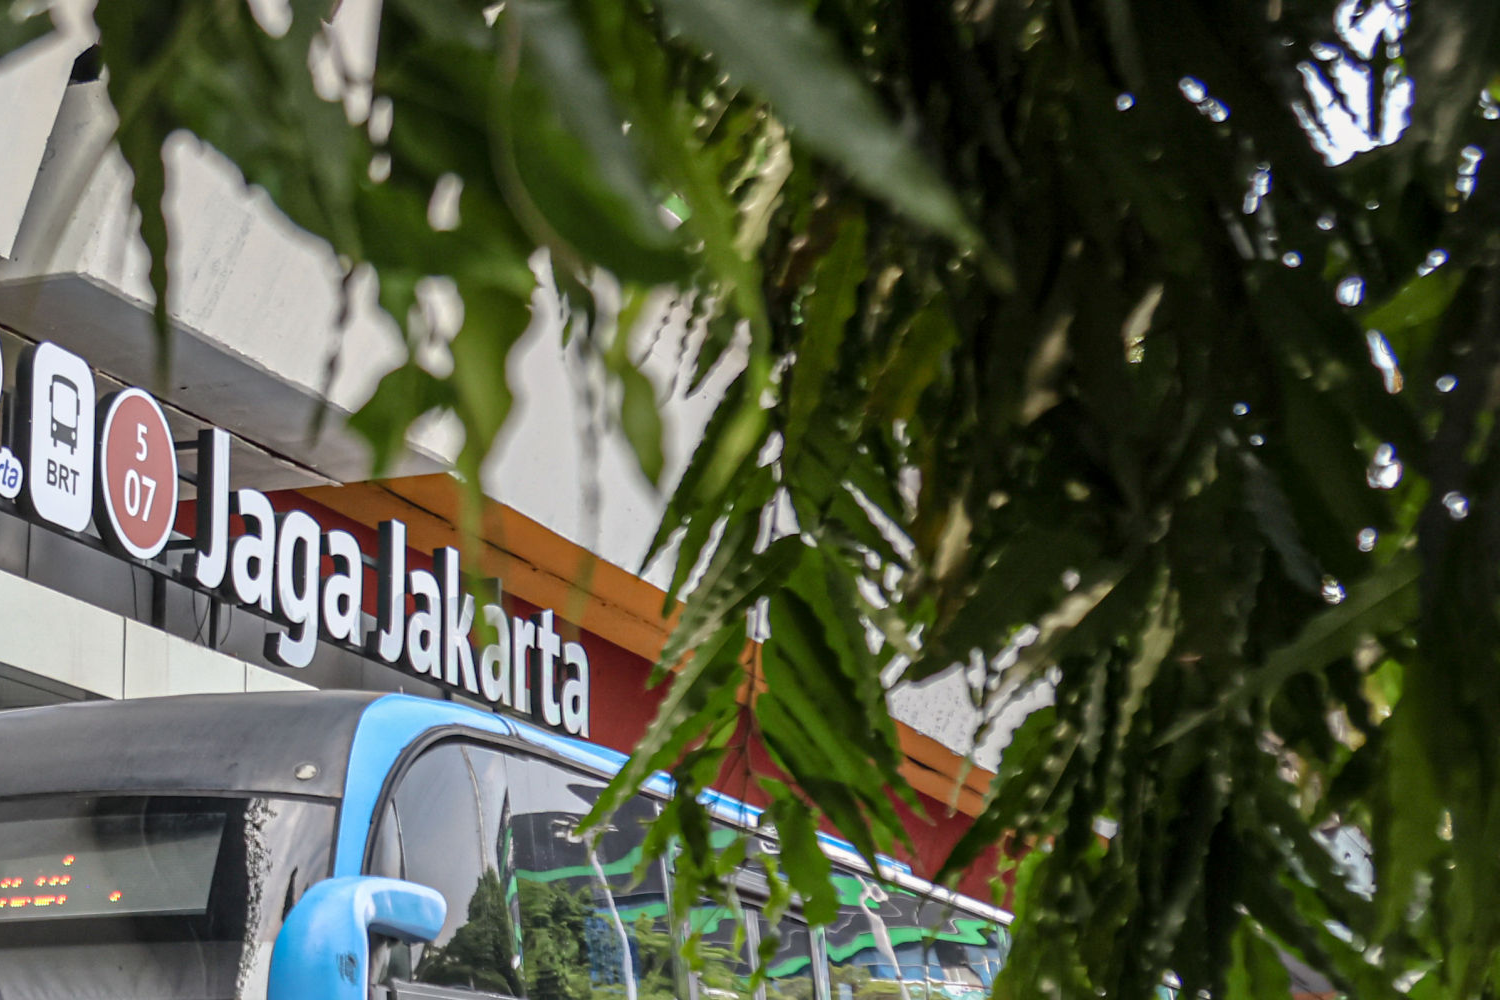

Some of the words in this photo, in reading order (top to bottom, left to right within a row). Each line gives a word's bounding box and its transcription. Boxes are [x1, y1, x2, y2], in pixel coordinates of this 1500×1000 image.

[135, 424, 149, 462] 5
[47, 459, 80, 496] BRT
[123, 469, 157, 522] 07
[194, 427, 364, 669] Jaga
[377, 518, 590, 739] Jakarta
